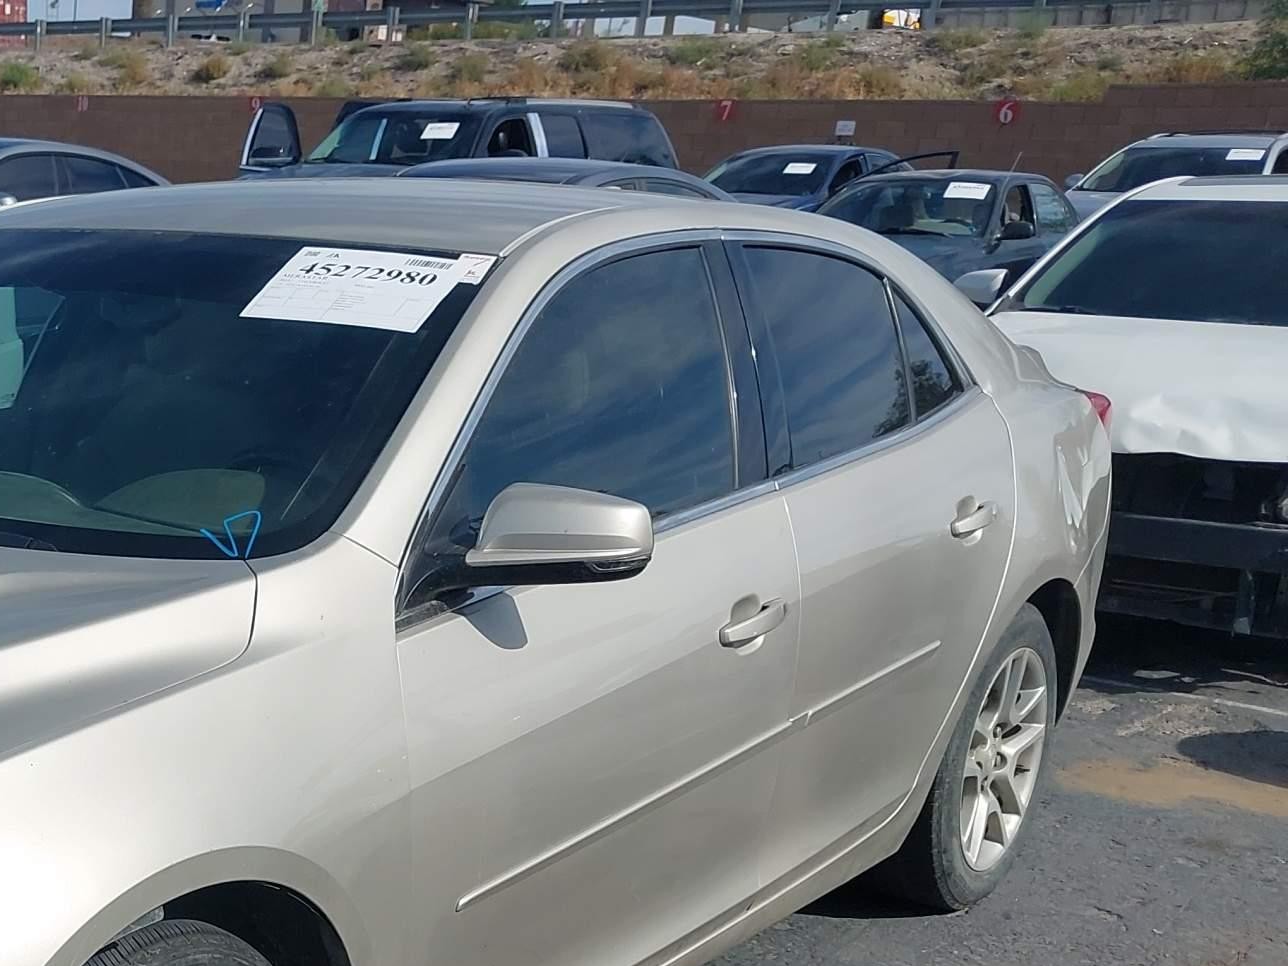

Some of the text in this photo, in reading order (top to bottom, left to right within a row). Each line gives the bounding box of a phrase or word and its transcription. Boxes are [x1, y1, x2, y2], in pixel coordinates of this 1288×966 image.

[252, 96, 260, 114] 9
[720, 100, 732, 120] 7
[999, 102, 1013, 124] 6
[299, 262, 438, 287] 45272980
